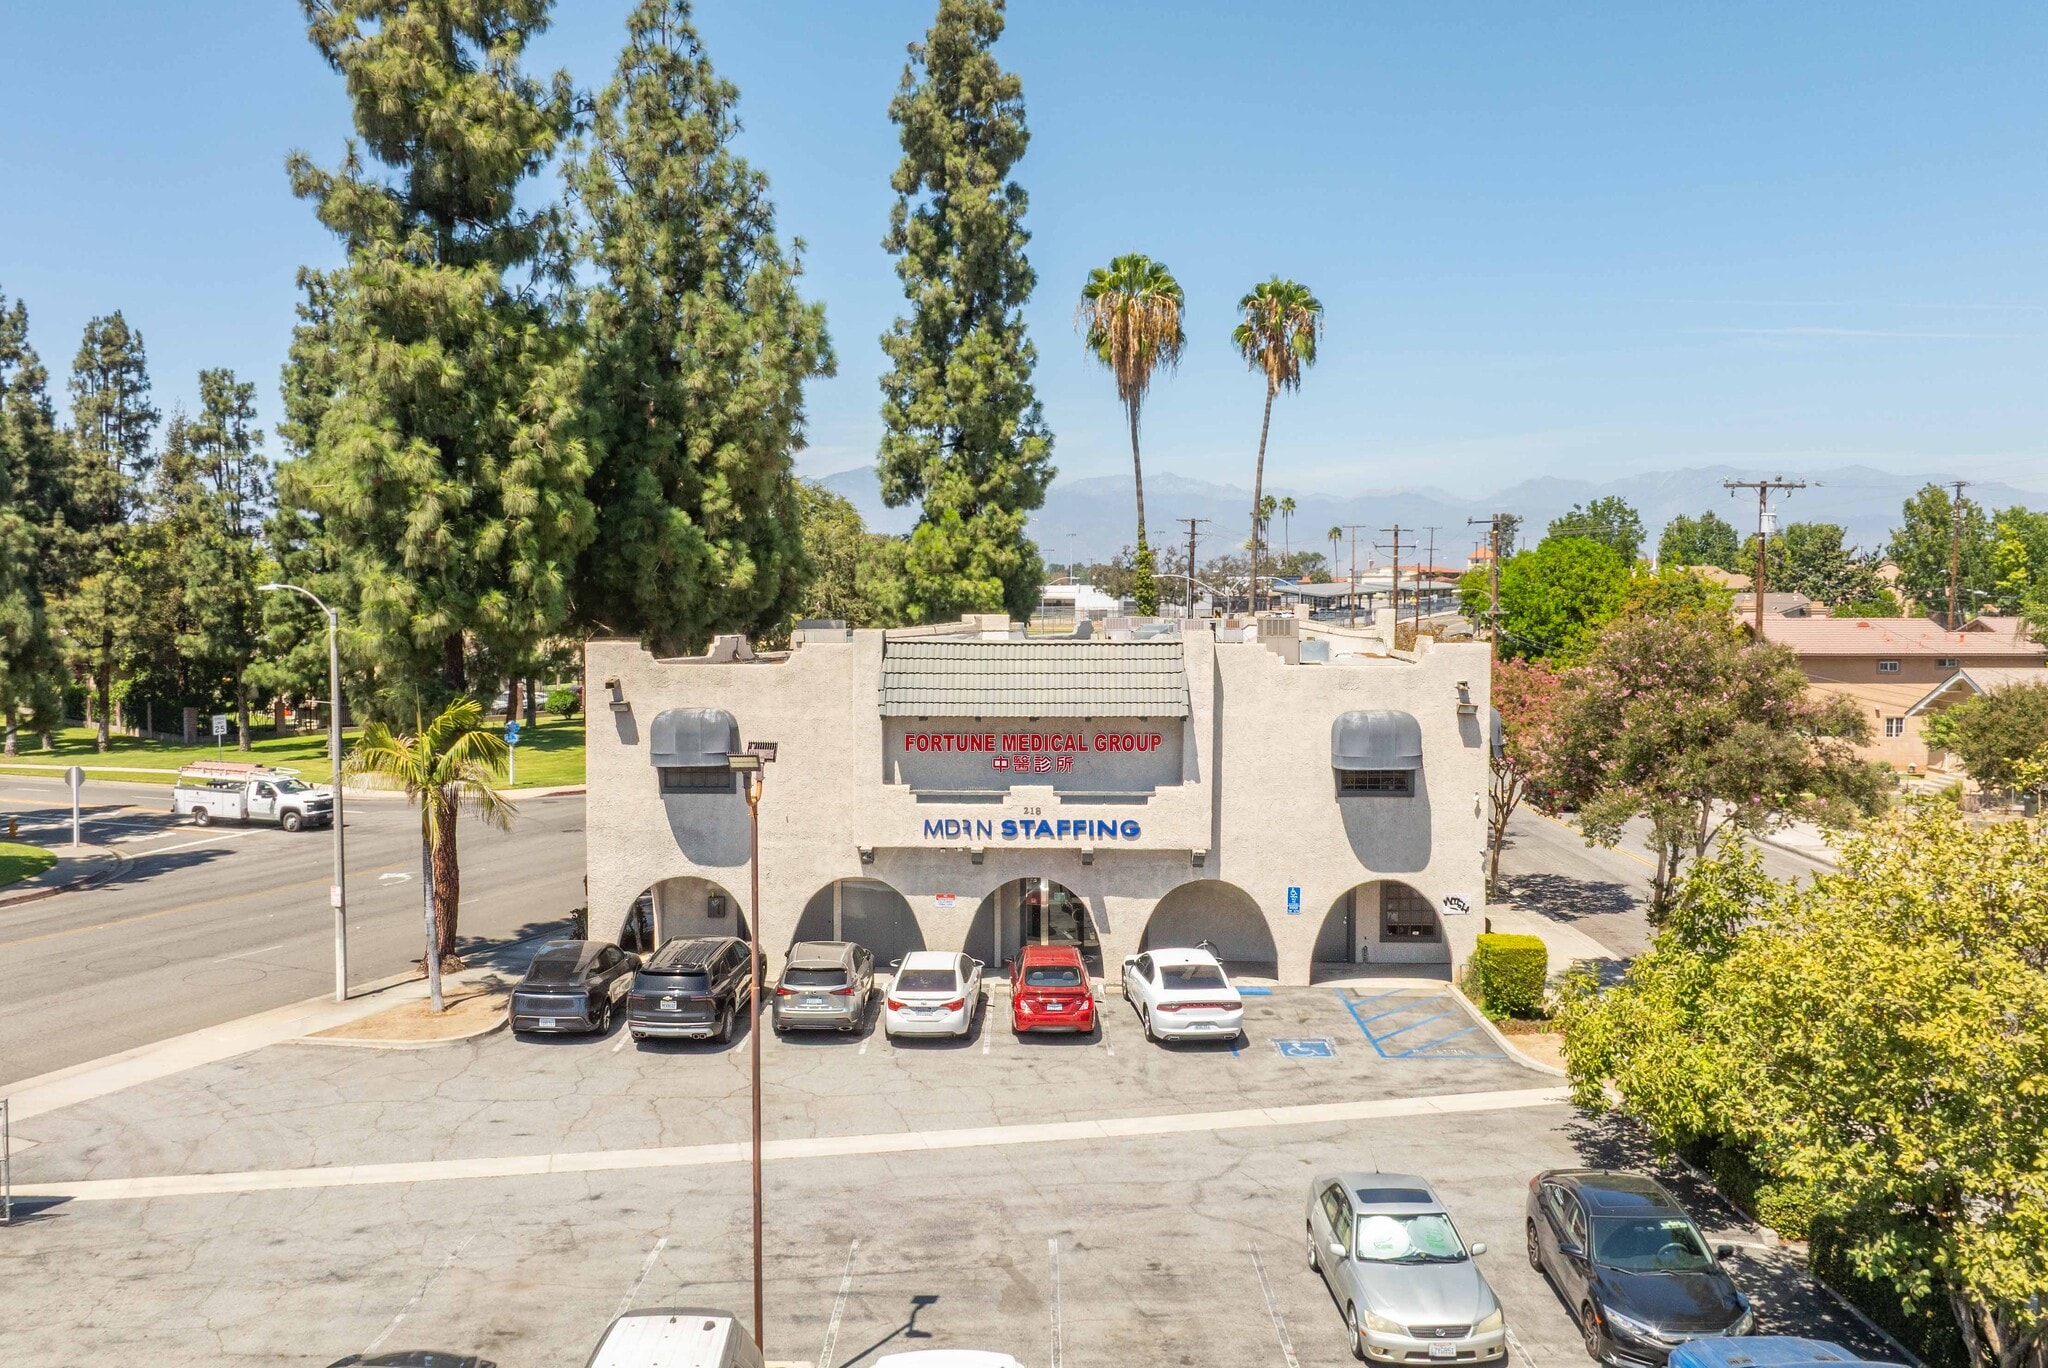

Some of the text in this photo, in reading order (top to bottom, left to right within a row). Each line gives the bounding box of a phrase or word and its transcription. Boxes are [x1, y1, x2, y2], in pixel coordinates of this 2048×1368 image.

[215, 725, 226, 733] 25
[904, 733, 1162, 752] FORTUNE MEDICAL GROUP
[992, 755, 1074, 774] 中醫診所
[1023, 807, 1042, 816] 218
[924, 819, 1141, 839] MDRN STAFFING
